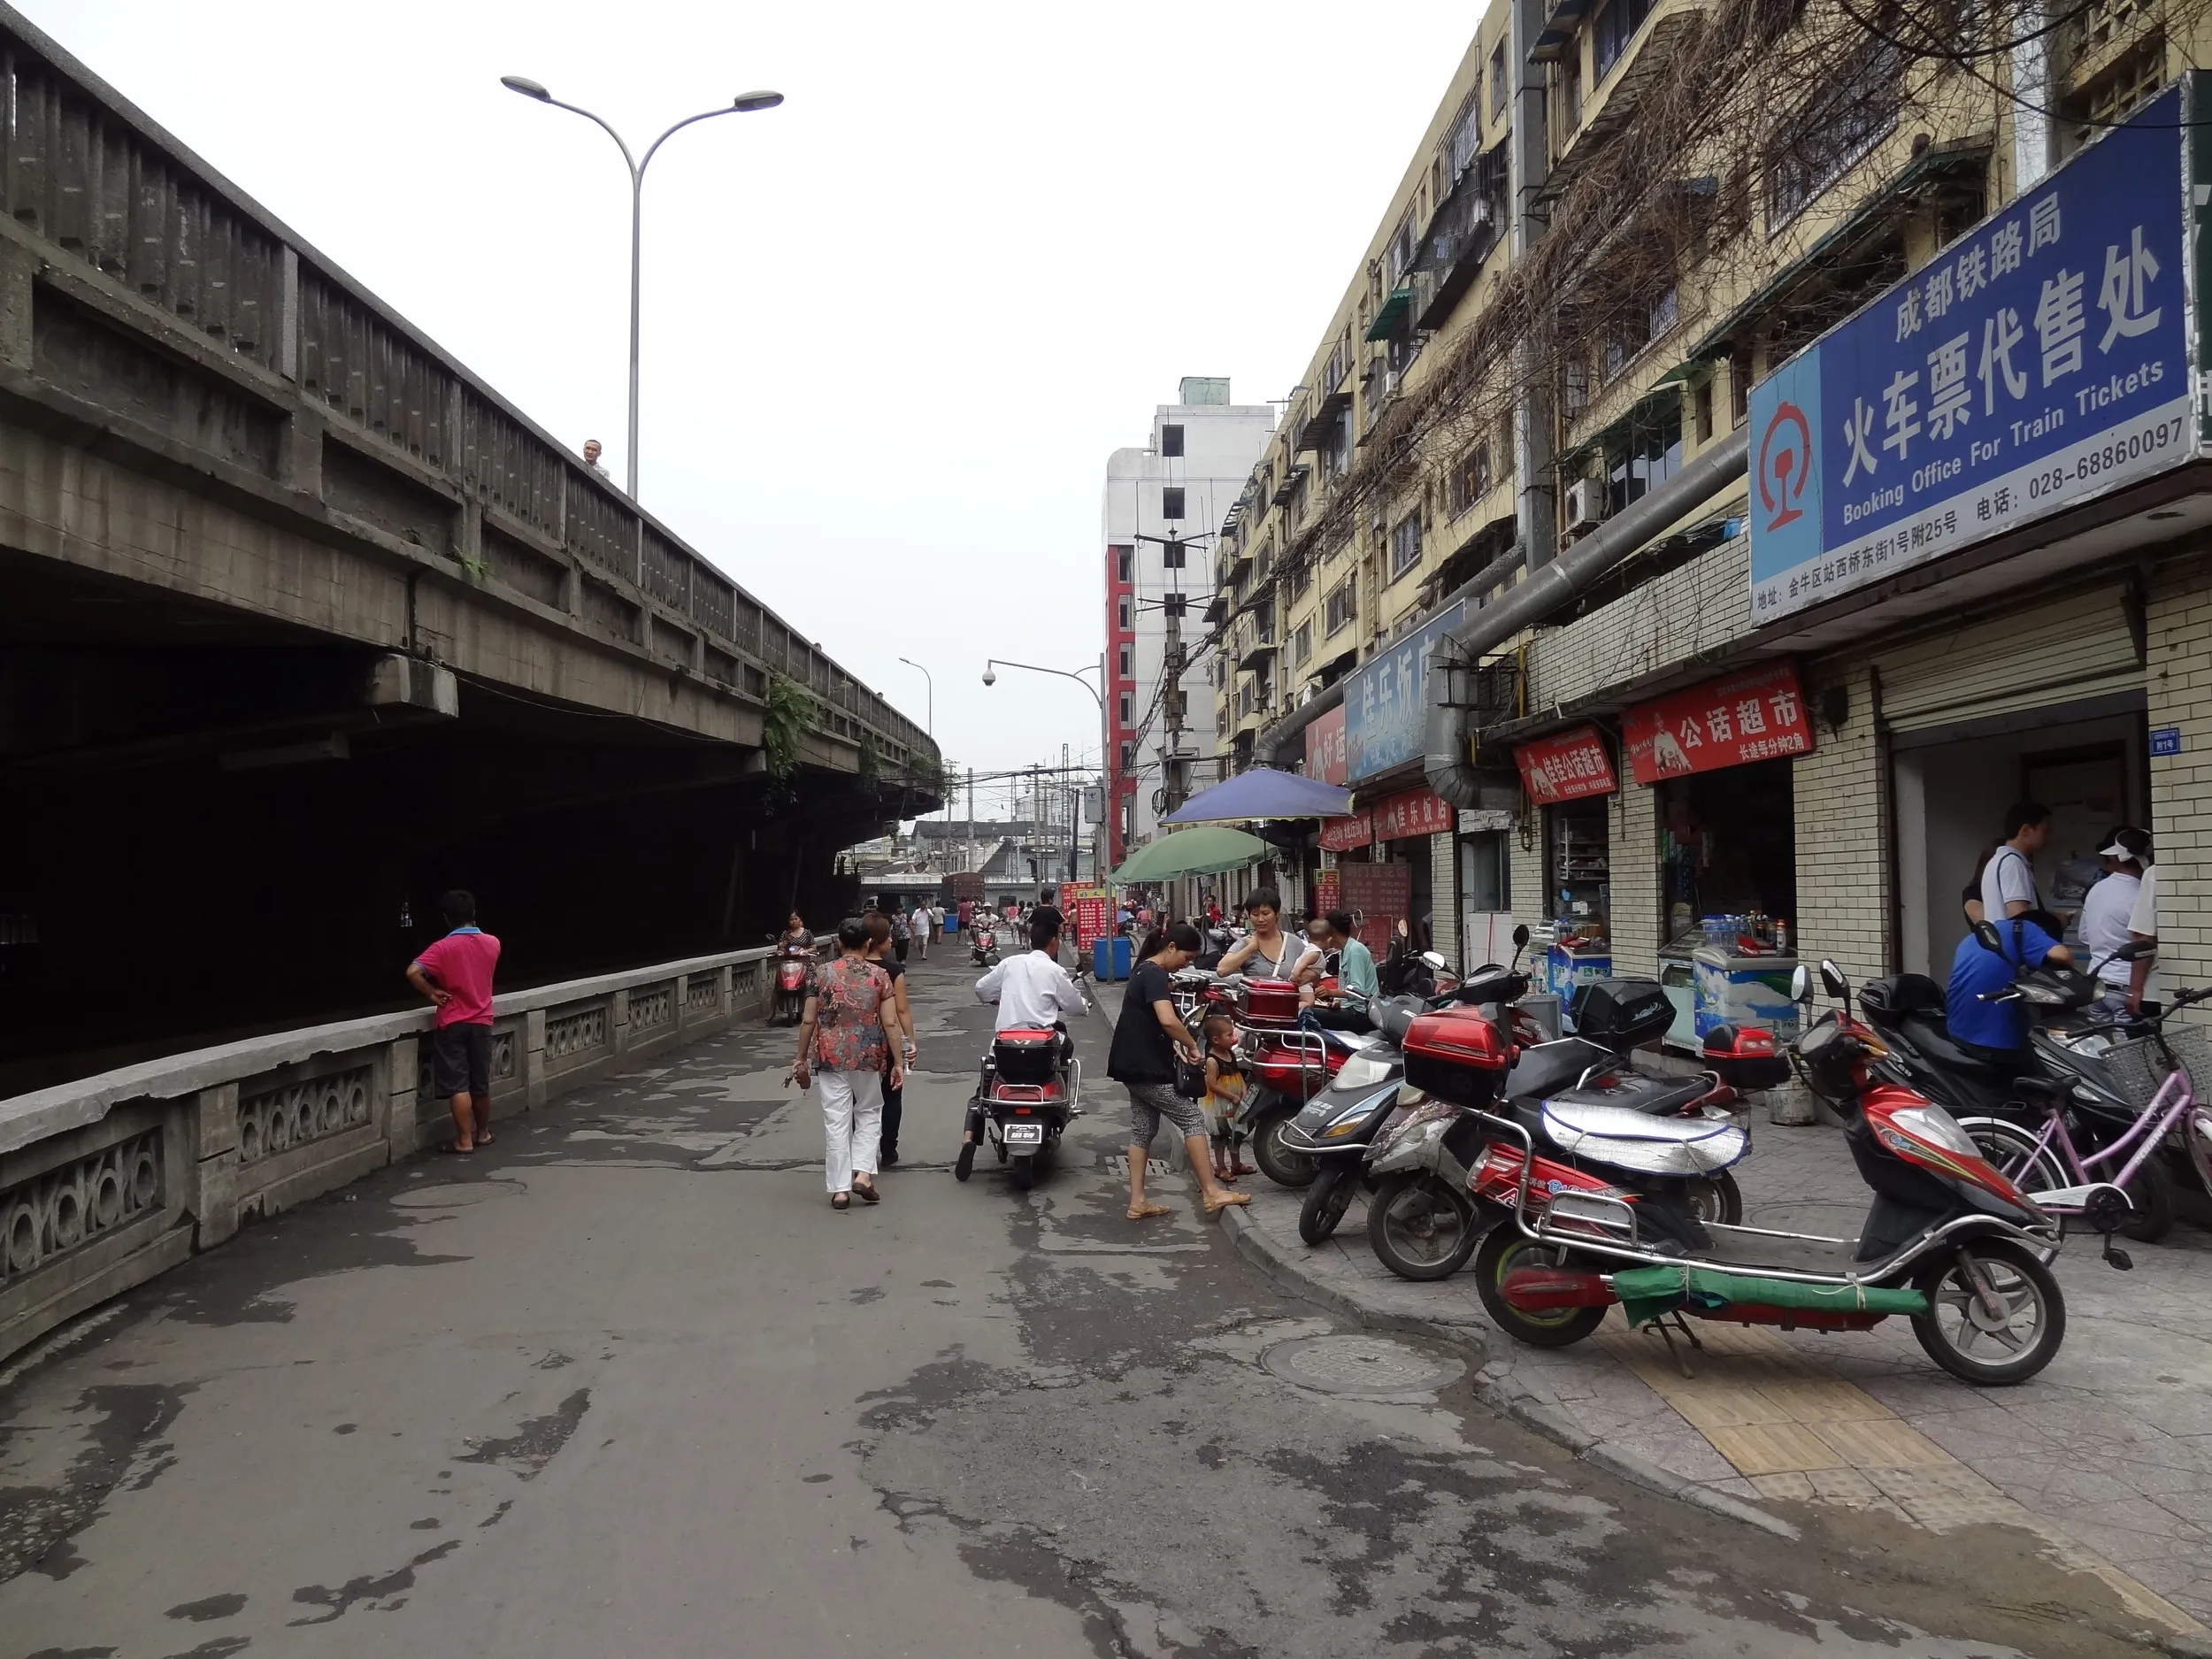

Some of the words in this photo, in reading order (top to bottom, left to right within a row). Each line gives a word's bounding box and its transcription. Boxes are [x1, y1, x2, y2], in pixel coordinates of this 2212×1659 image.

[1895, 191, 2062, 343] 成都铁路局
[1841, 224, 2163, 488] 火车票代售处
[1843, 486, 1903, 526] Booking
[1911, 455, 1962, 493] Office
[1970, 437, 2001, 466] For
[2010, 407, 2064, 447] Train
[2075, 360, 2164, 417] Tickets
[1680, 689, 1798, 749] 公话超市
[1739, 732, 1805, 761] 长途每分钟2角
[1542, 744, 1606, 785] 佳佳公话超市
[1397, 795, 1447, 828] 佳乐饭店
